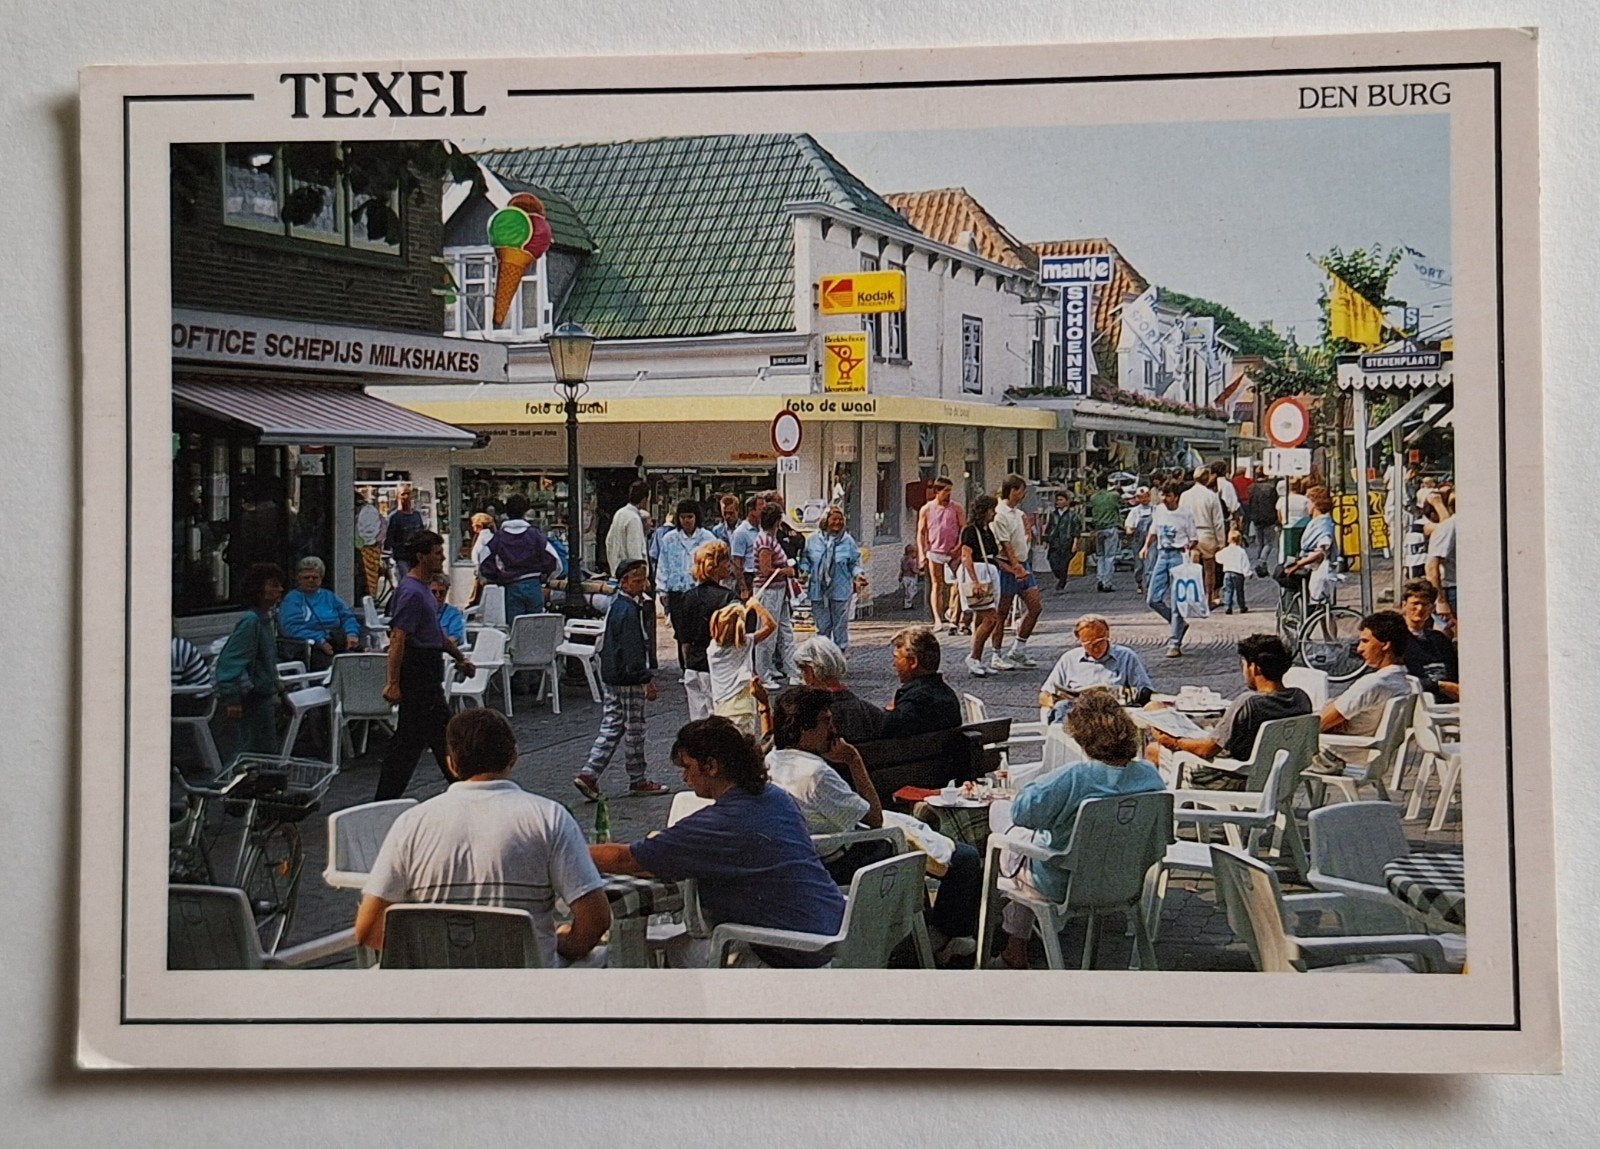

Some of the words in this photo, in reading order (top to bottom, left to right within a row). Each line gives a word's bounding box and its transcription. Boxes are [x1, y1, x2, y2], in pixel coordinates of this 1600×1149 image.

[1043, 258, 1109, 281] mantje
[857, 290, 895, 302] Kodak
[172, 323, 257, 355] OFTICE
[264, 332, 363, 364] SCHEPIJS
[369, 343, 481, 374] MILKSHAKES
[1066, 287, 1084, 394] SCHOENEN
[525, 402, 551, 415] foto
[786, 399, 815, 412] foto
[819, 399, 837, 412] de
[841, 399, 877, 412] waal
